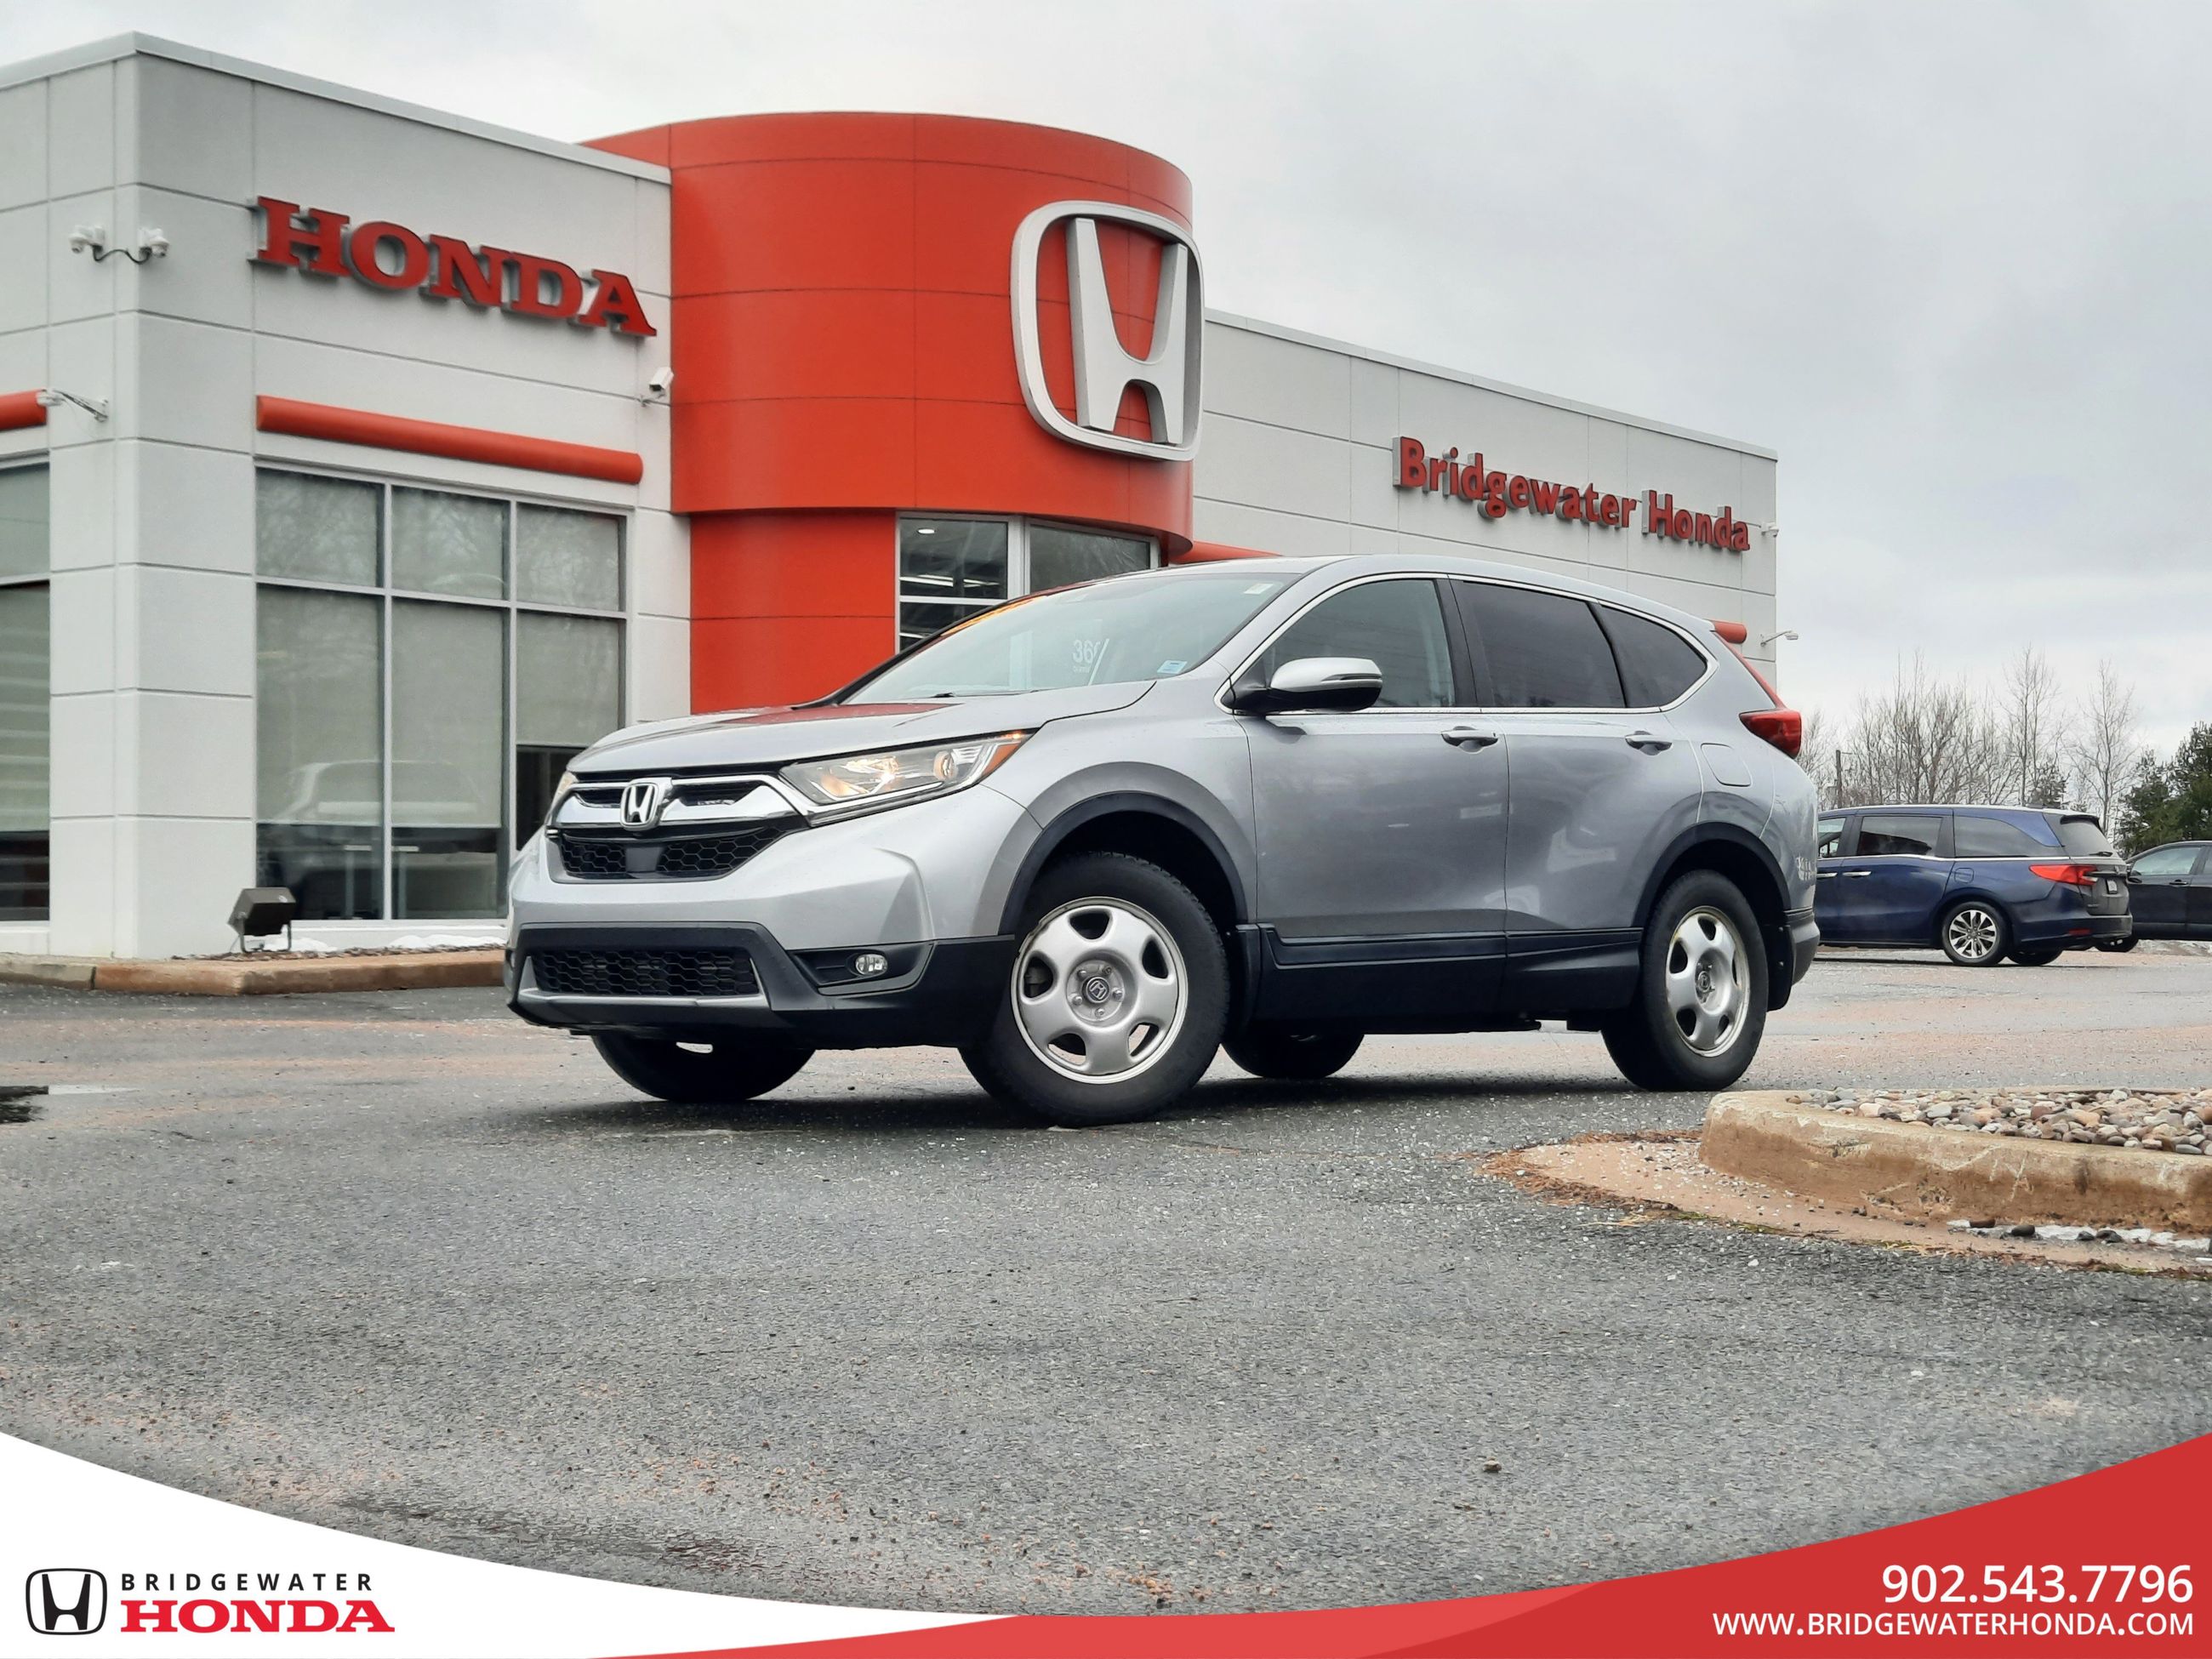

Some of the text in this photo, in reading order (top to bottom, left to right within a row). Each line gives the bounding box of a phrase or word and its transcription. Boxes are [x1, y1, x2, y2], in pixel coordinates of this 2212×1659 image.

[257, 196, 658, 337] HONDA
[1399, 436, 1751, 551] Bridgewater Honda
